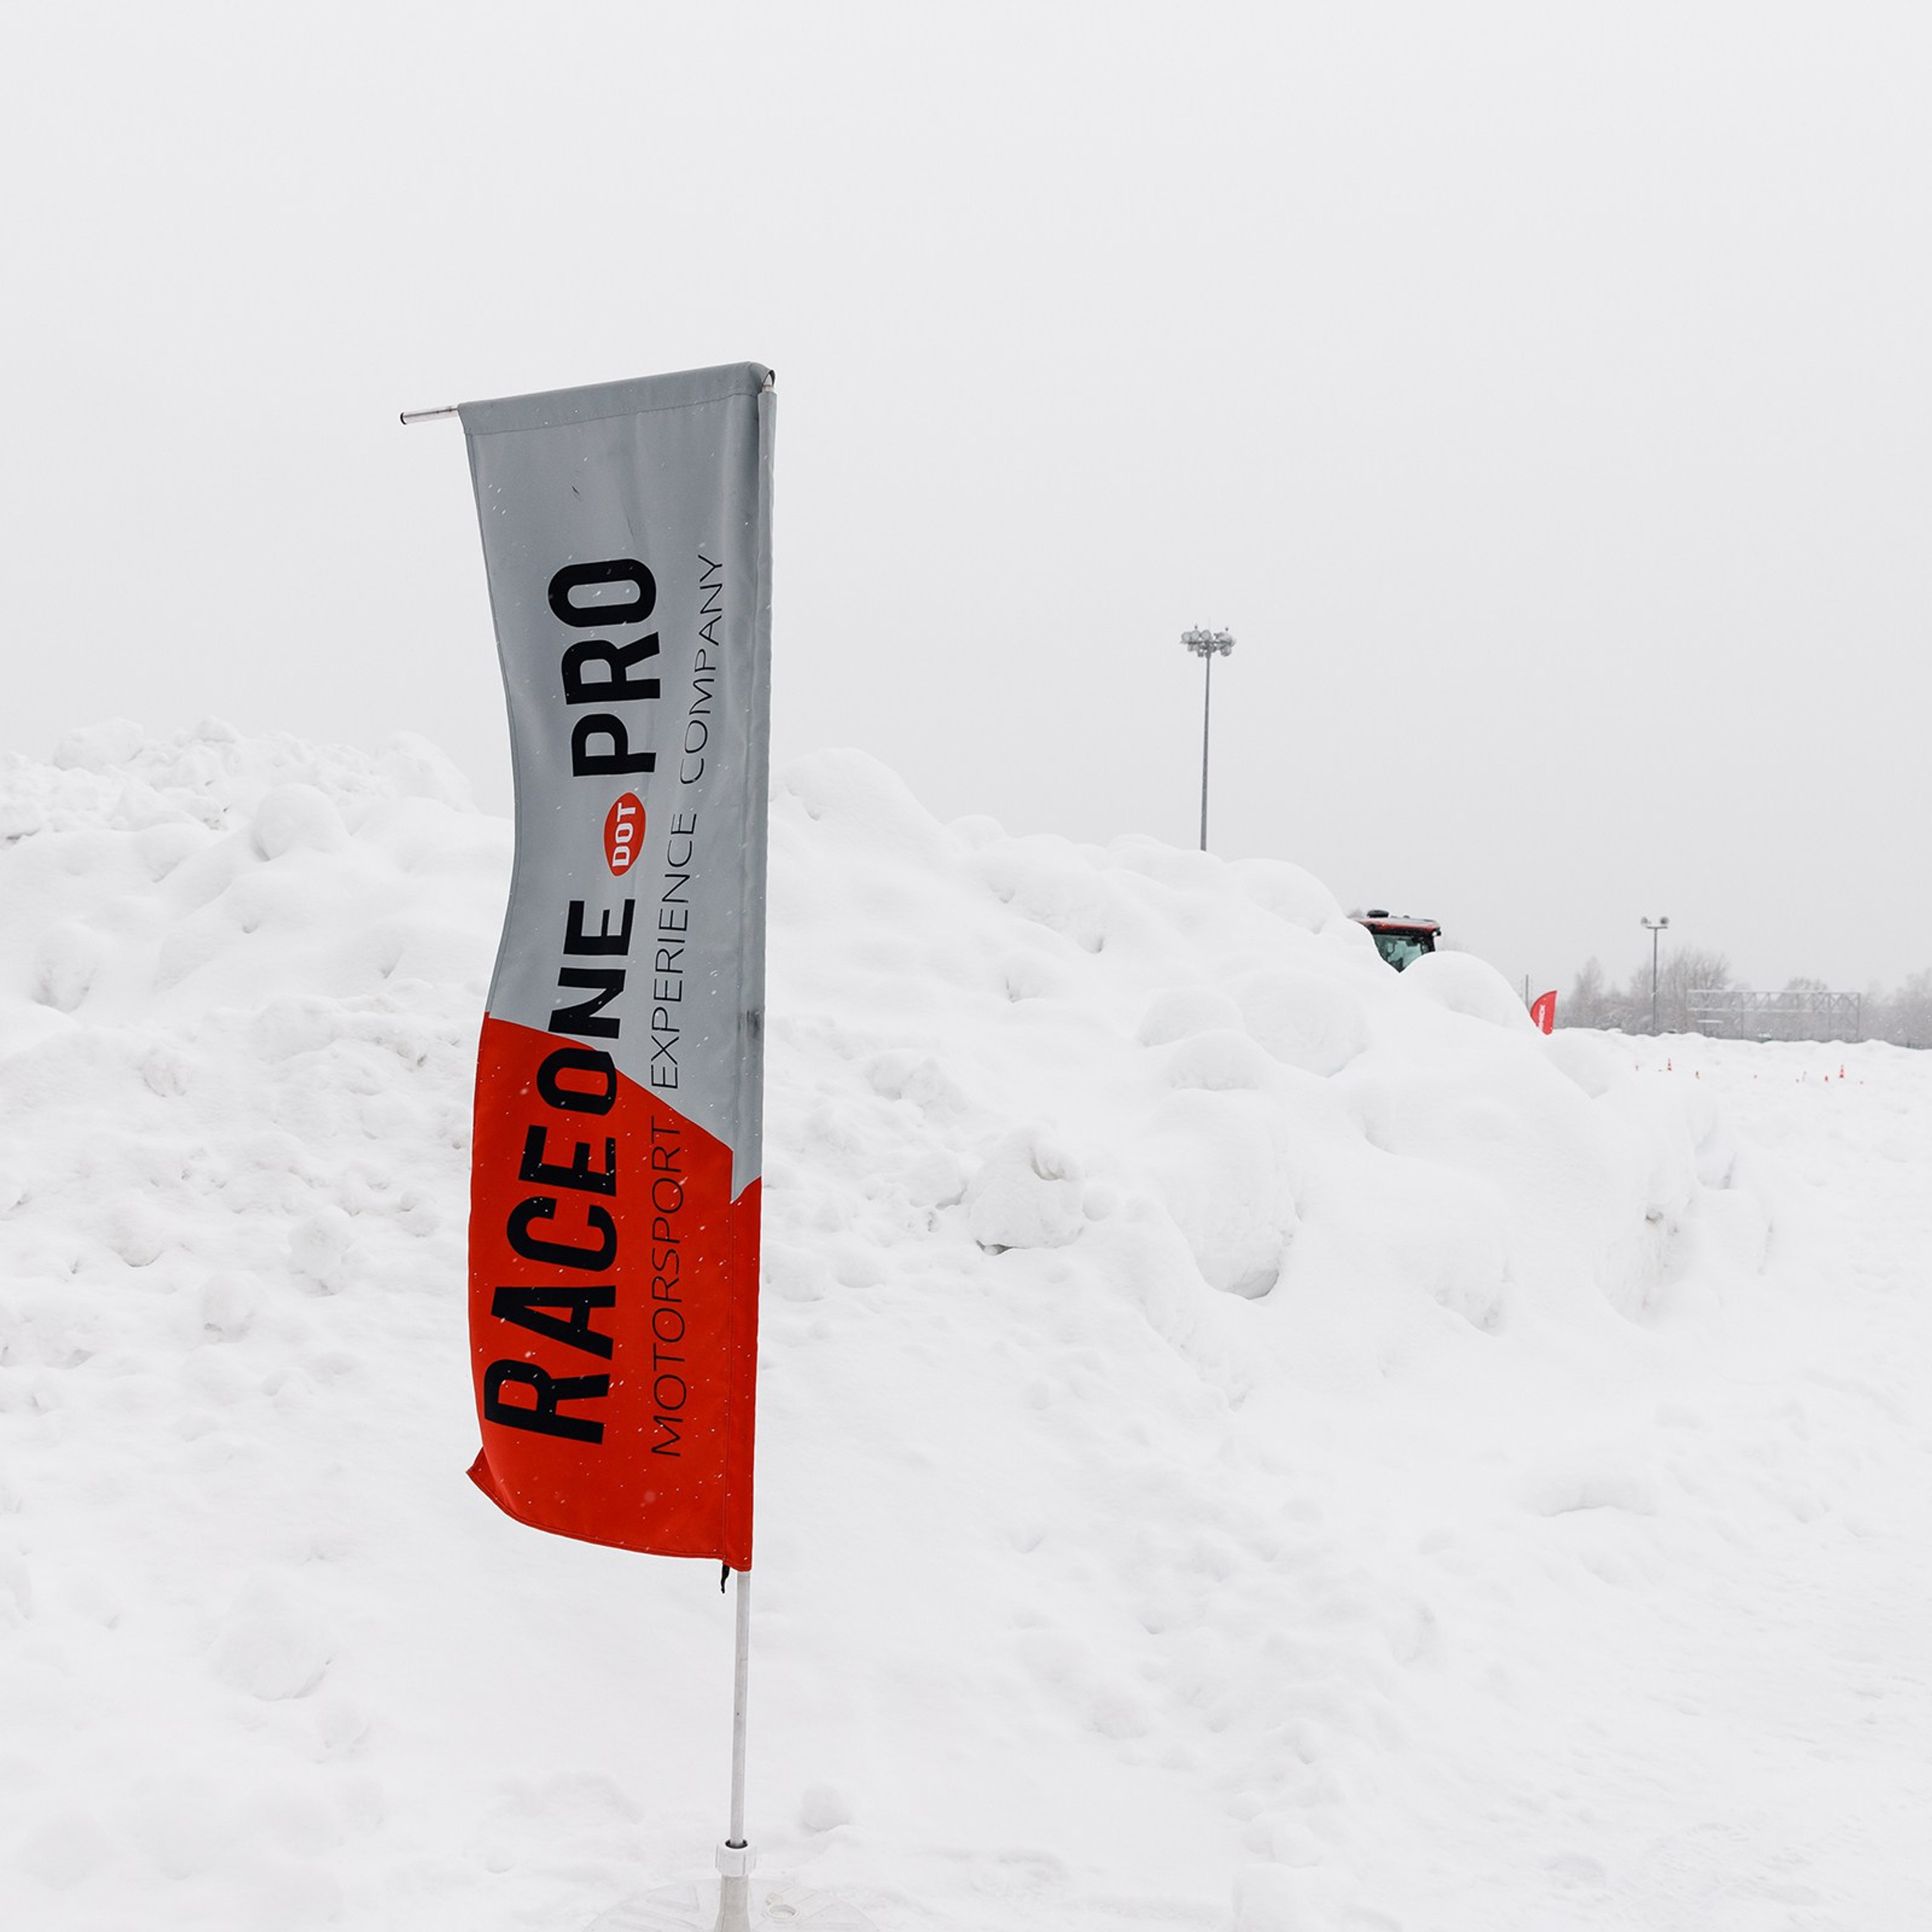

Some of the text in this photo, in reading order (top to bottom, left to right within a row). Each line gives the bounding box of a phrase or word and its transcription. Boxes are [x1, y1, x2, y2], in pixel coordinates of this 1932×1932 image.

[547, 558, 660, 777] PRO
[611, 802, 636, 868] DOT
[651, 553, 723, 1458] MOTORSPORT EXPERIENCE COMPANY
